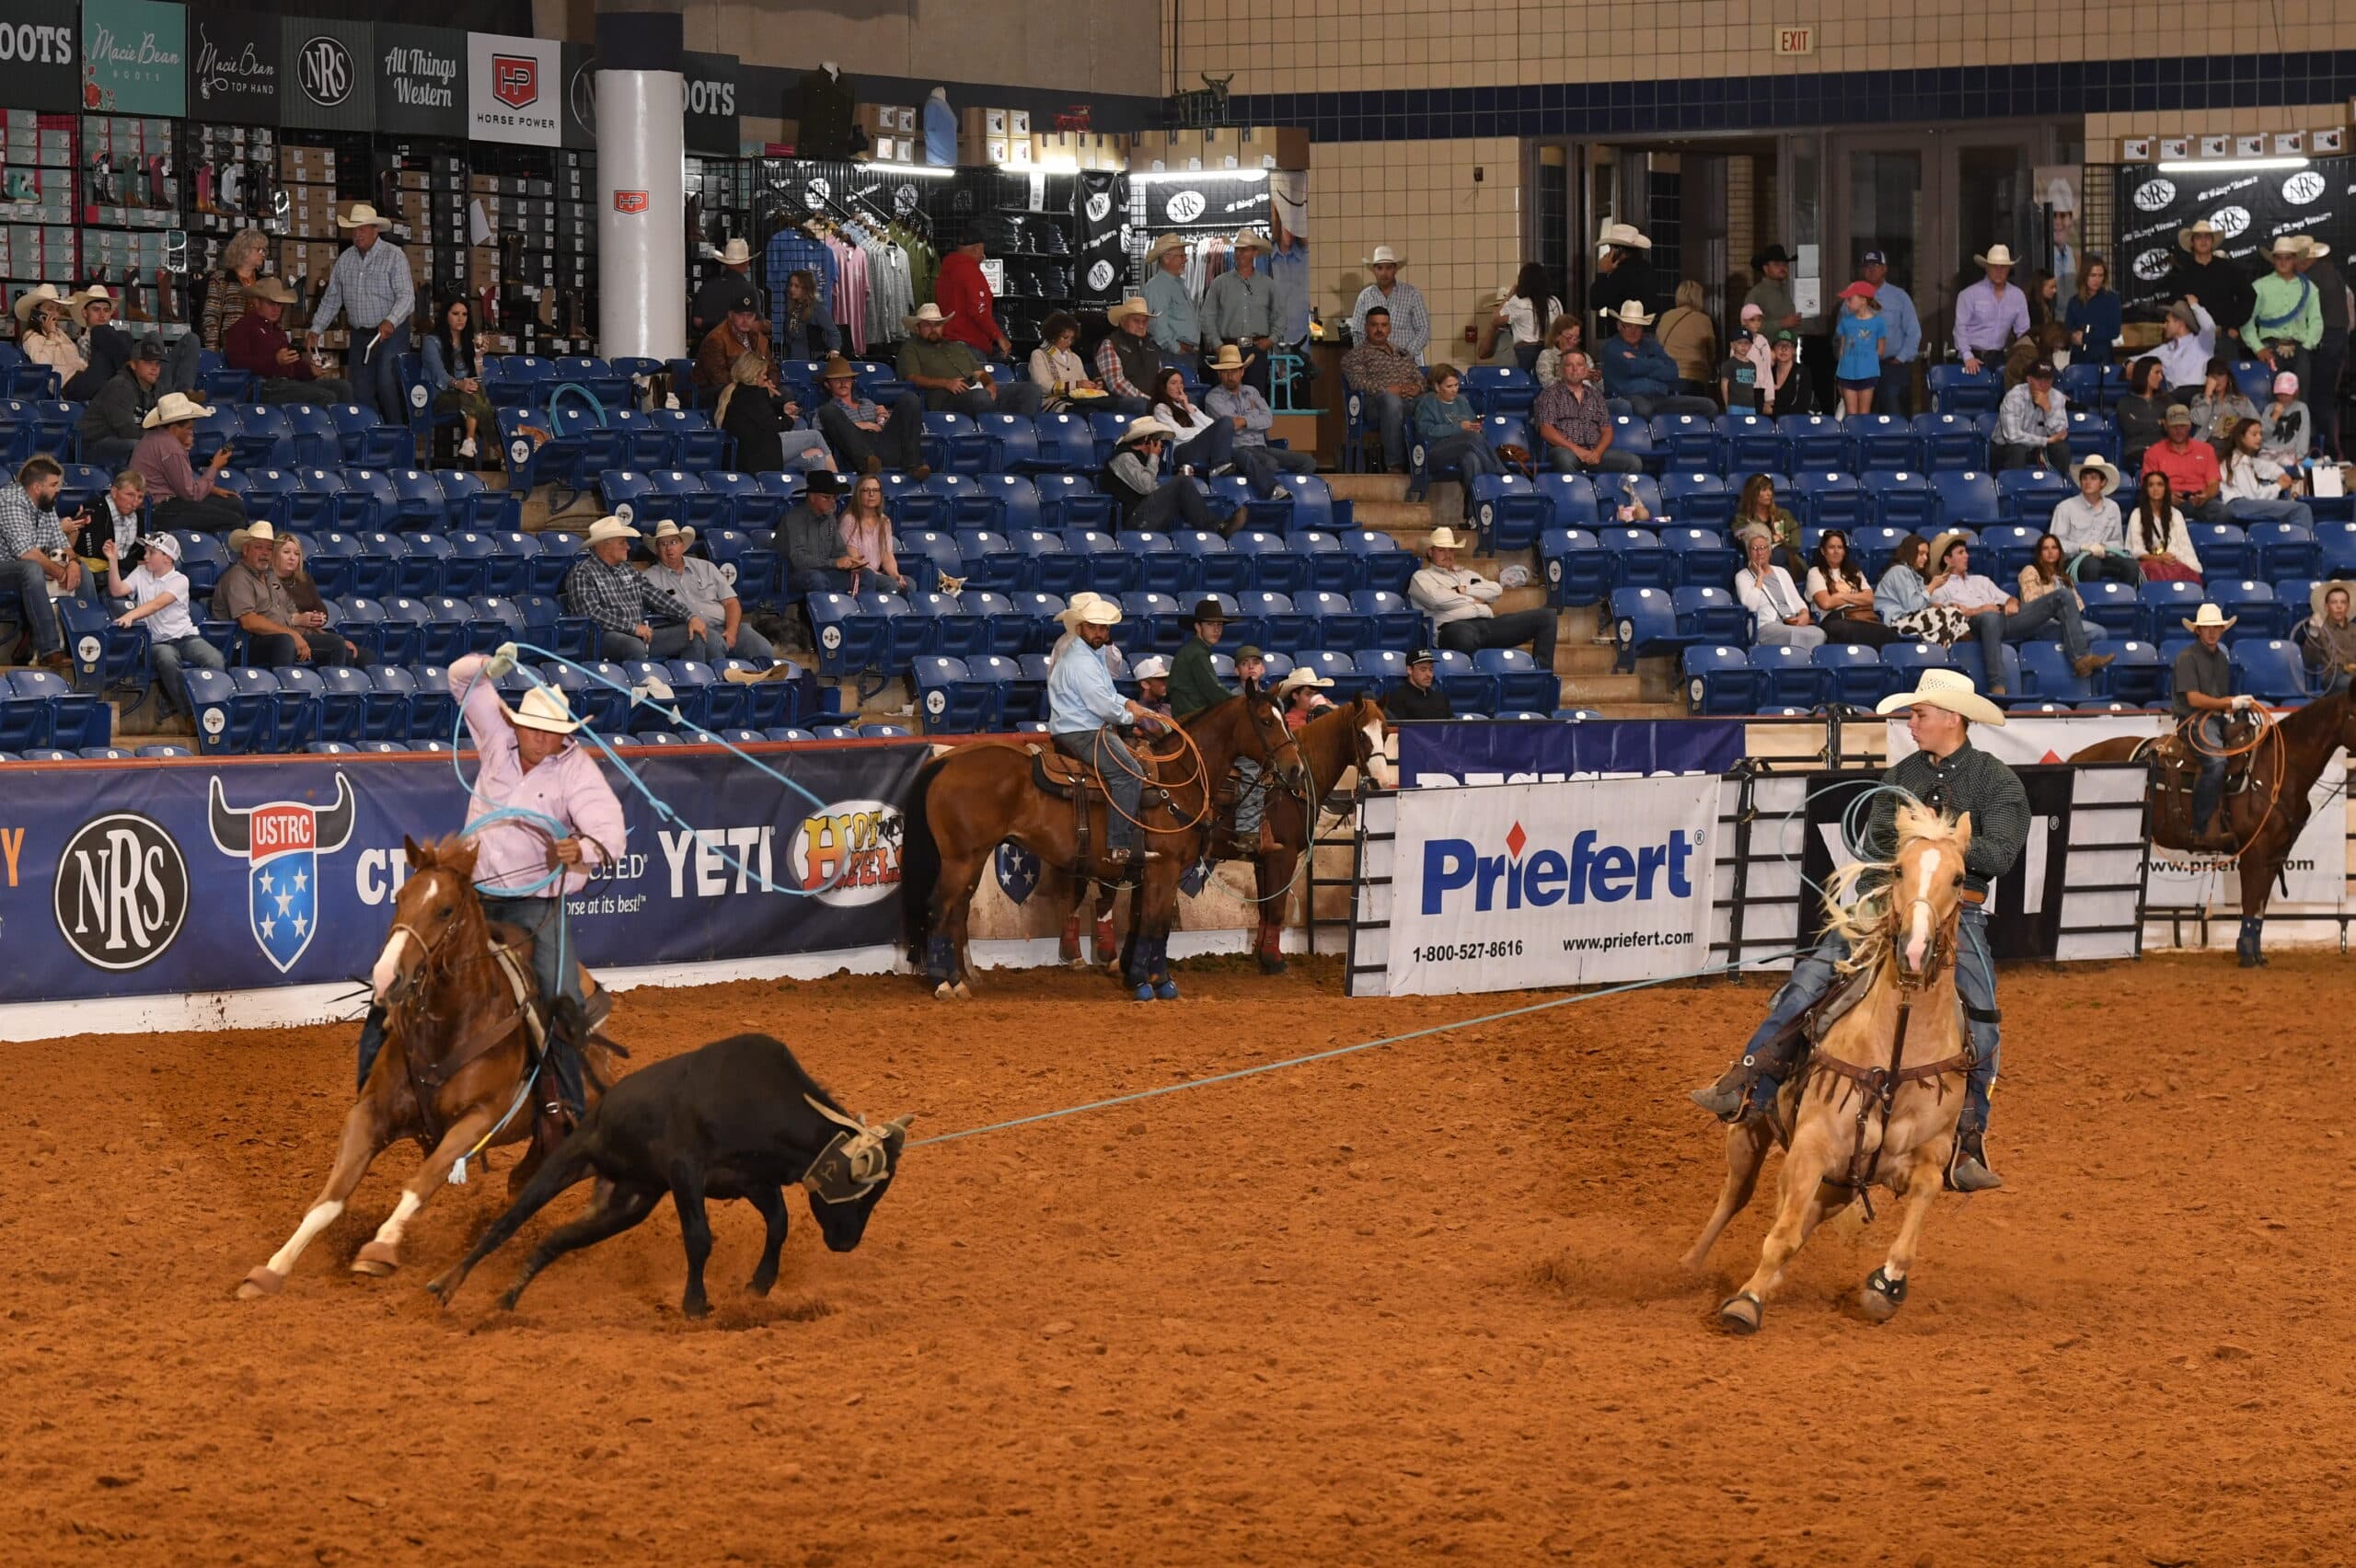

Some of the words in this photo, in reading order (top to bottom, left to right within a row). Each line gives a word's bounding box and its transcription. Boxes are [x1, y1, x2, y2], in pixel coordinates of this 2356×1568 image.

[93, 23, 137, 65] Macie
[139, 31, 179, 64] Bean
[196, 23, 238, 78] Macie
[238, 42, 274, 75] Bean
[1782, 30, 1808, 52] EXIT
[306, 43, 347, 98] NRS
[385, 47, 407, 75] All
[409, 48, 456, 85] Things
[231, 82, 248, 92] TOP
[250, 83, 274, 95] HAND
[393, 76, 452, 108] Western
[477, 113, 514, 126] HORSE
[519, 114, 555, 129] POWER
[256, 814, 311, 845] USTRC
[75, 829, 166, 949] NRS
[588, 898, 599, 915] at
[601, 894, 614, 914] its
[1413, 940, 1523, 963] 1-800-527-8616
[1563, 930, 1693, 952] www.priefert.com
